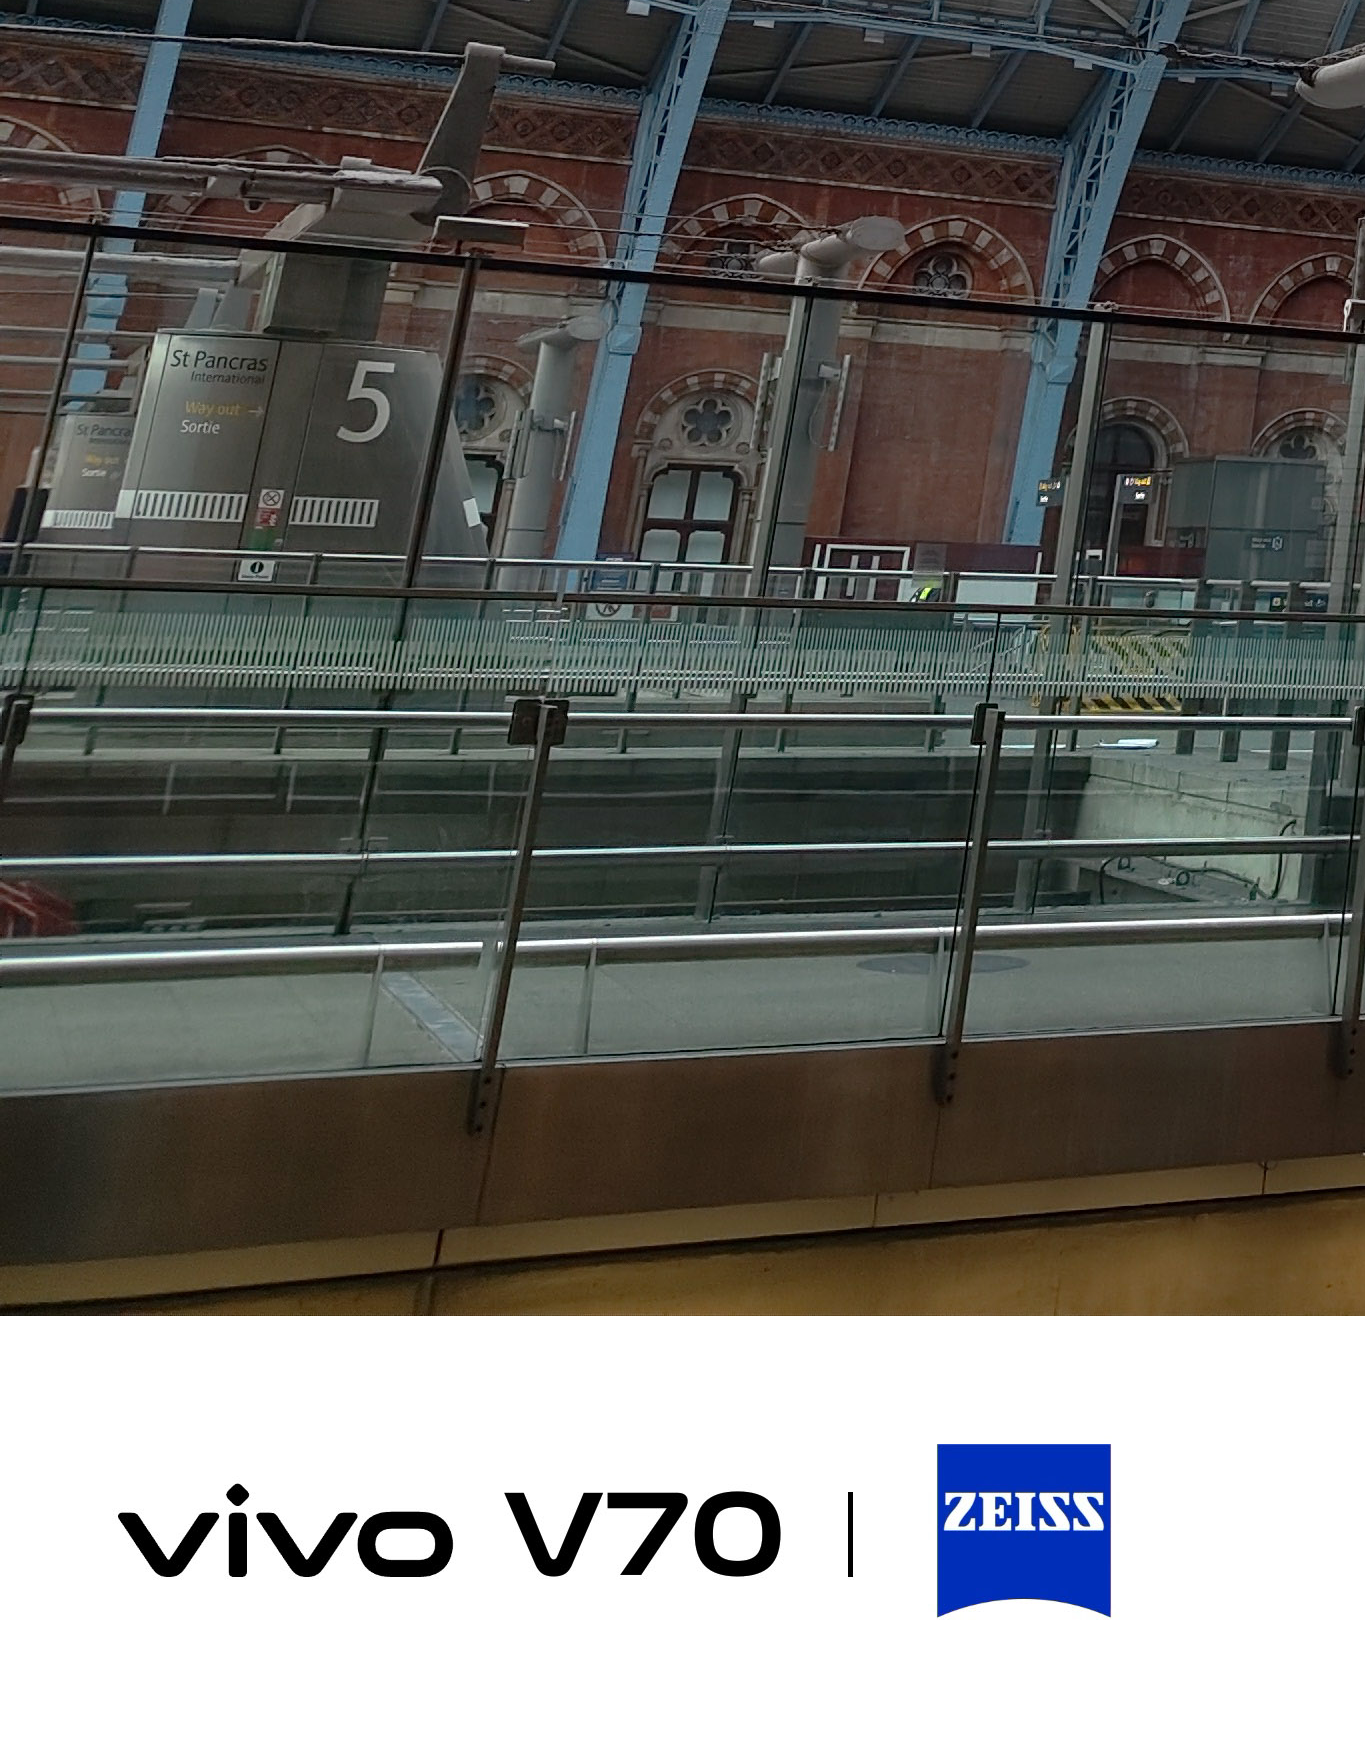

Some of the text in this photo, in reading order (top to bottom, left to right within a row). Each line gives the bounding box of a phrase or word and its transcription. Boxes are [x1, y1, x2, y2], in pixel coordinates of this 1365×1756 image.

[170, 349, 269, 372] St Pancras
[190, 370, 266, 385] International
[185, 400, 241, 418] Way out
[336, 359, 396, 444] 5
[90, 424, 133, 437] Pancra
[180, 419, 221, 435] Sortie
